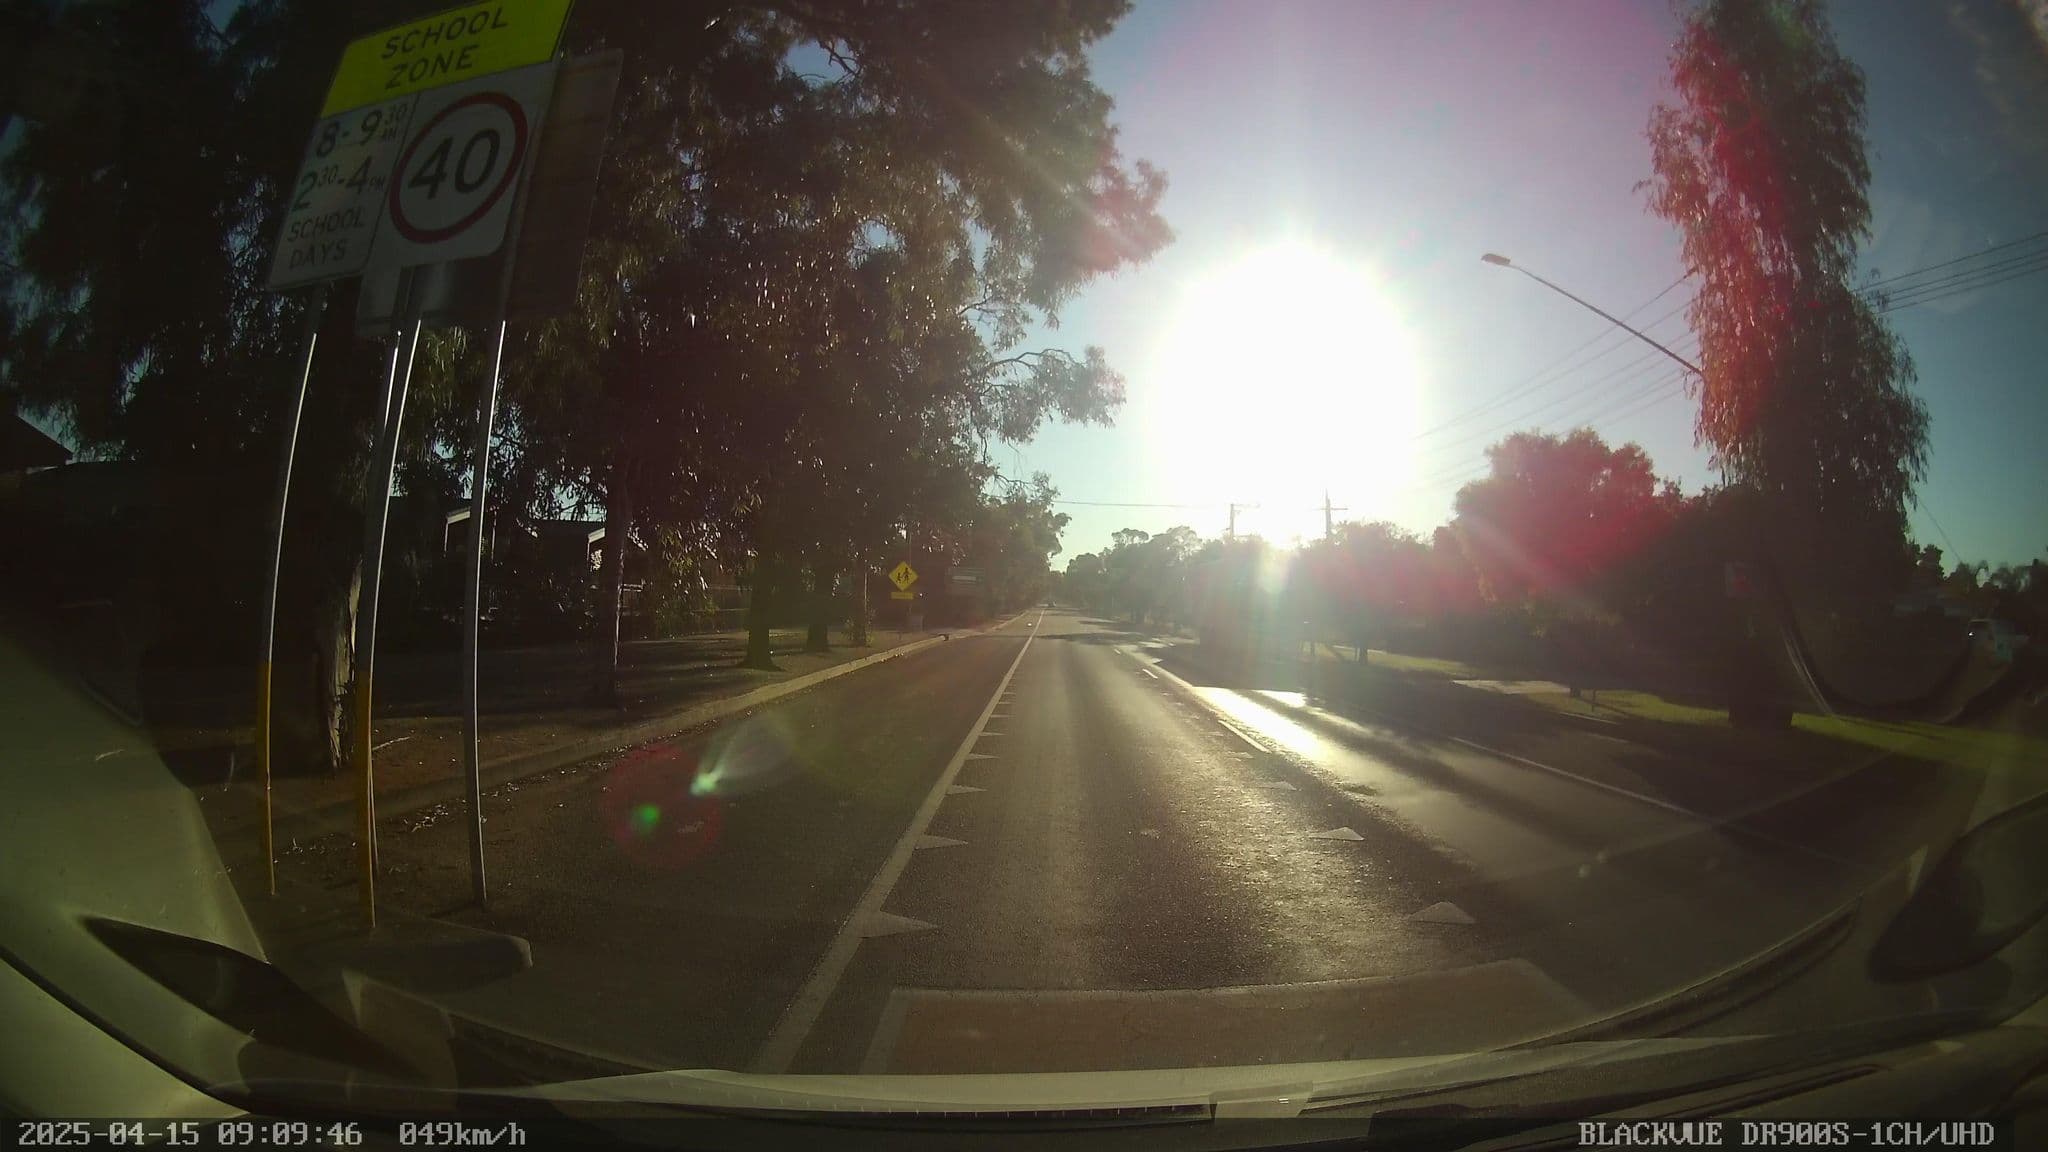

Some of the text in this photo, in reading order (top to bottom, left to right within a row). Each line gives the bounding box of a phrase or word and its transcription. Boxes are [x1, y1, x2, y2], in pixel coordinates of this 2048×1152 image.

[381, 7, 508, 59] SCHOOL
[385, 44, 480, 90] ZONE
[407, 128, 500, 200] 40
[289, 207, 364, 240] SCHOOL
[289, 240, 347, 270] DAYS
